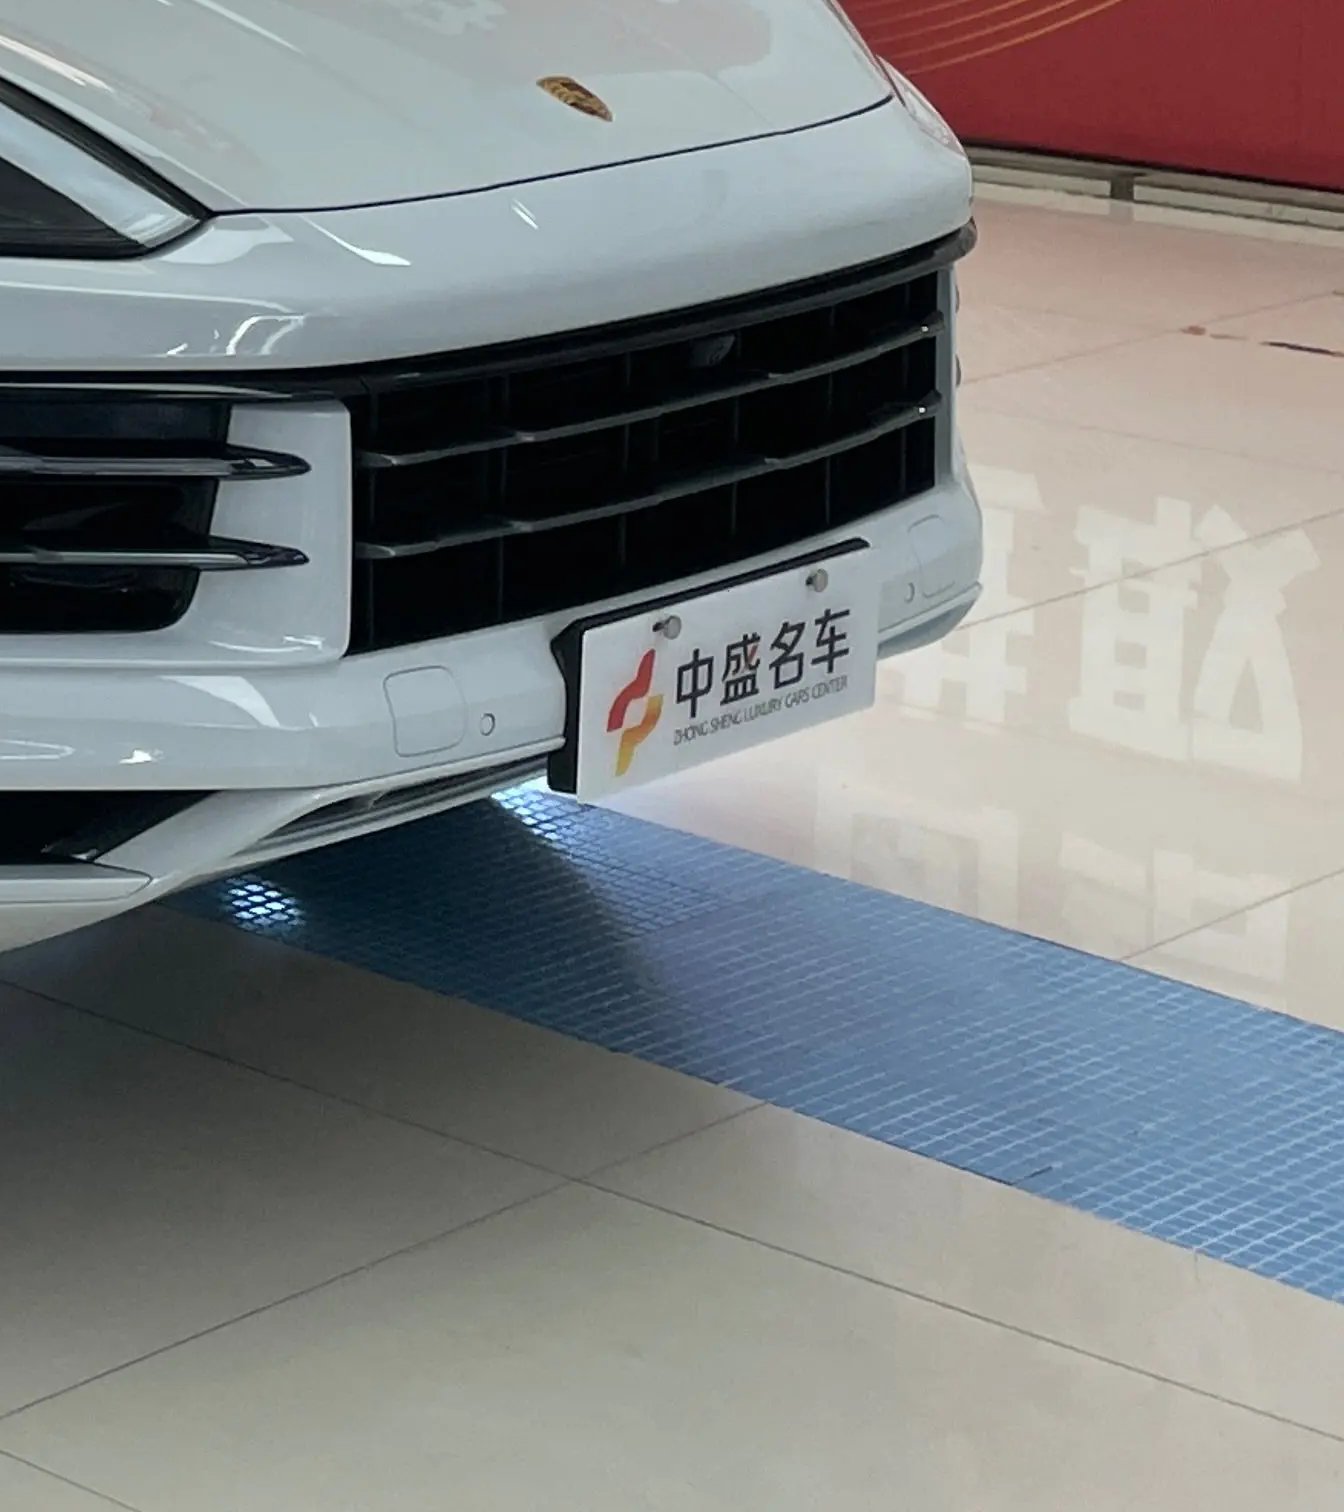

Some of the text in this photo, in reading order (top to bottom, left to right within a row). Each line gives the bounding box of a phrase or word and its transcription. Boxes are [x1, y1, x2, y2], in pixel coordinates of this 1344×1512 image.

[673, 608, 852, 719] 中盛名车
[709, 710, 742, 734] SHENG
[743, 694, 785, 723] LUXURY
[784, 685, 811, 709] CARS
[811, 674, 849, 700] CENTER
